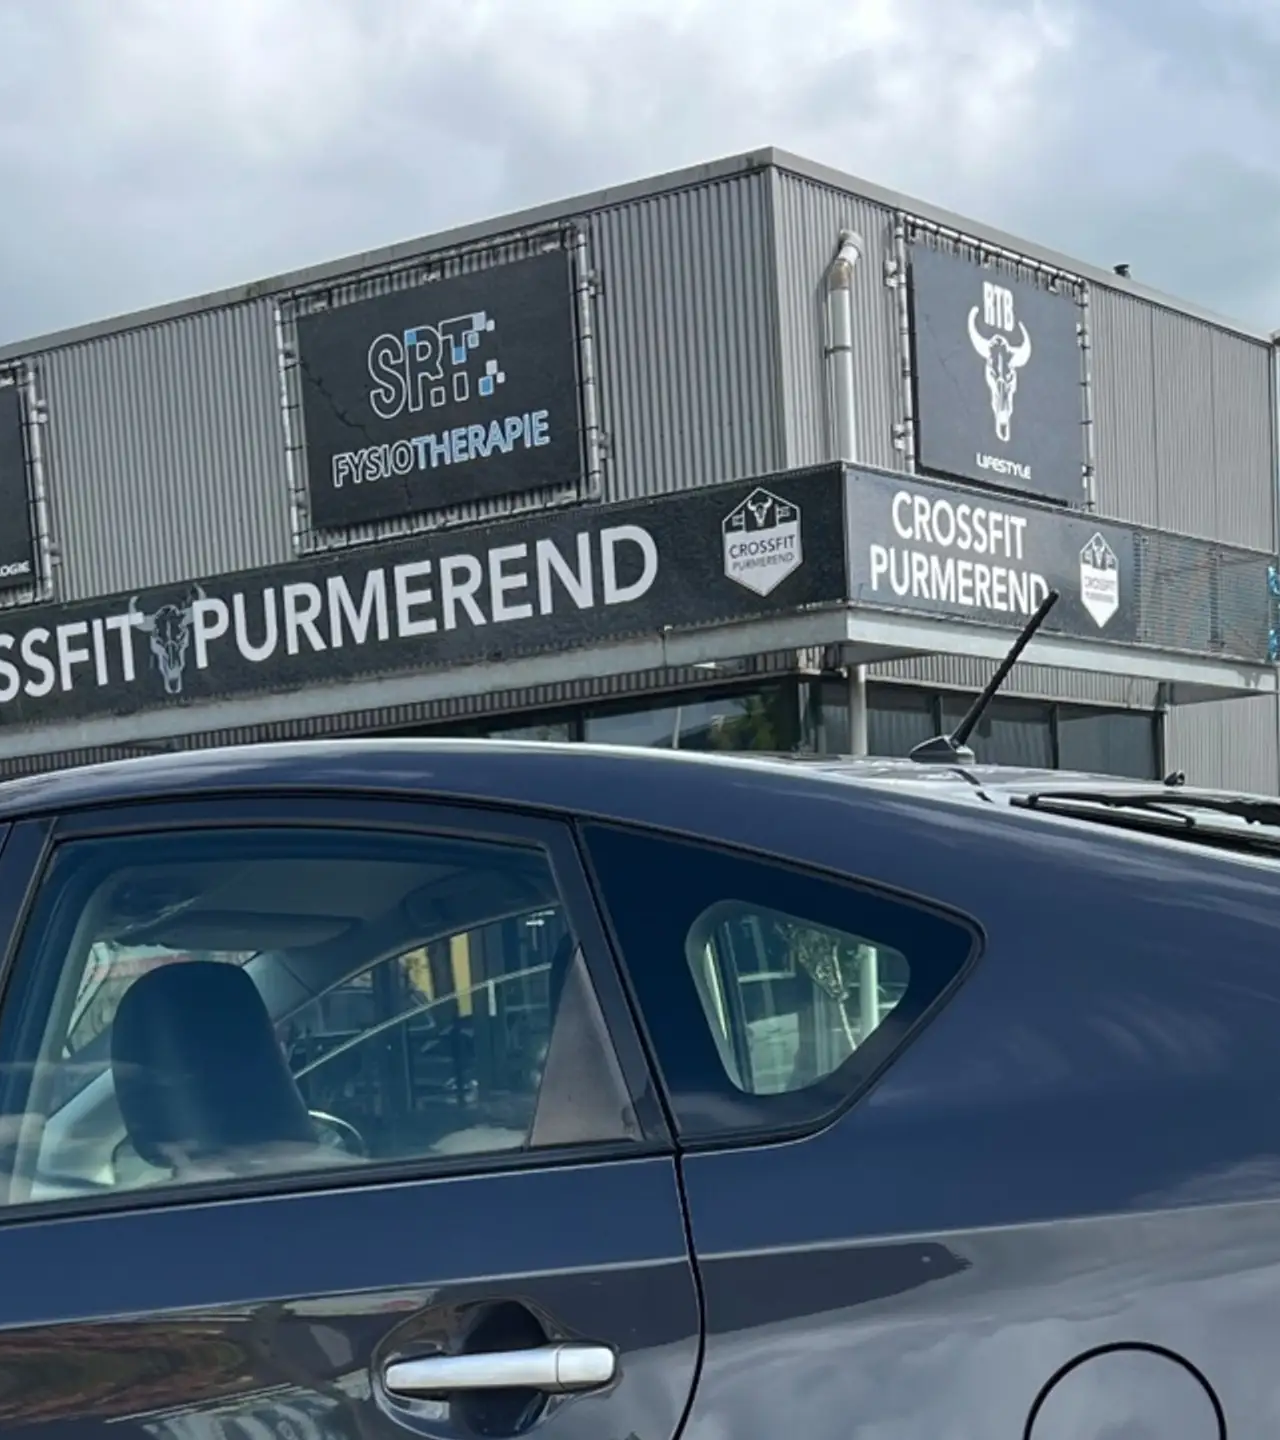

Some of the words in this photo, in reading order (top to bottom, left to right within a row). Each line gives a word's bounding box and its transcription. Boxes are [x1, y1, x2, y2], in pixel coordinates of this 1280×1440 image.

[983, 281, 1014, 331] RTB
[332, 409, 551, 487] FYSIOTHERAPIE
[976, 452, 1031, 479] LIFESTYLE
[730, 535, 795, 559] CROSSFIT
[892, 491, 1027, 559] CROSSFIT
[192, 525, 658, 669] PURMEREND
[870, 544, 1050, 615] PURMEREND
